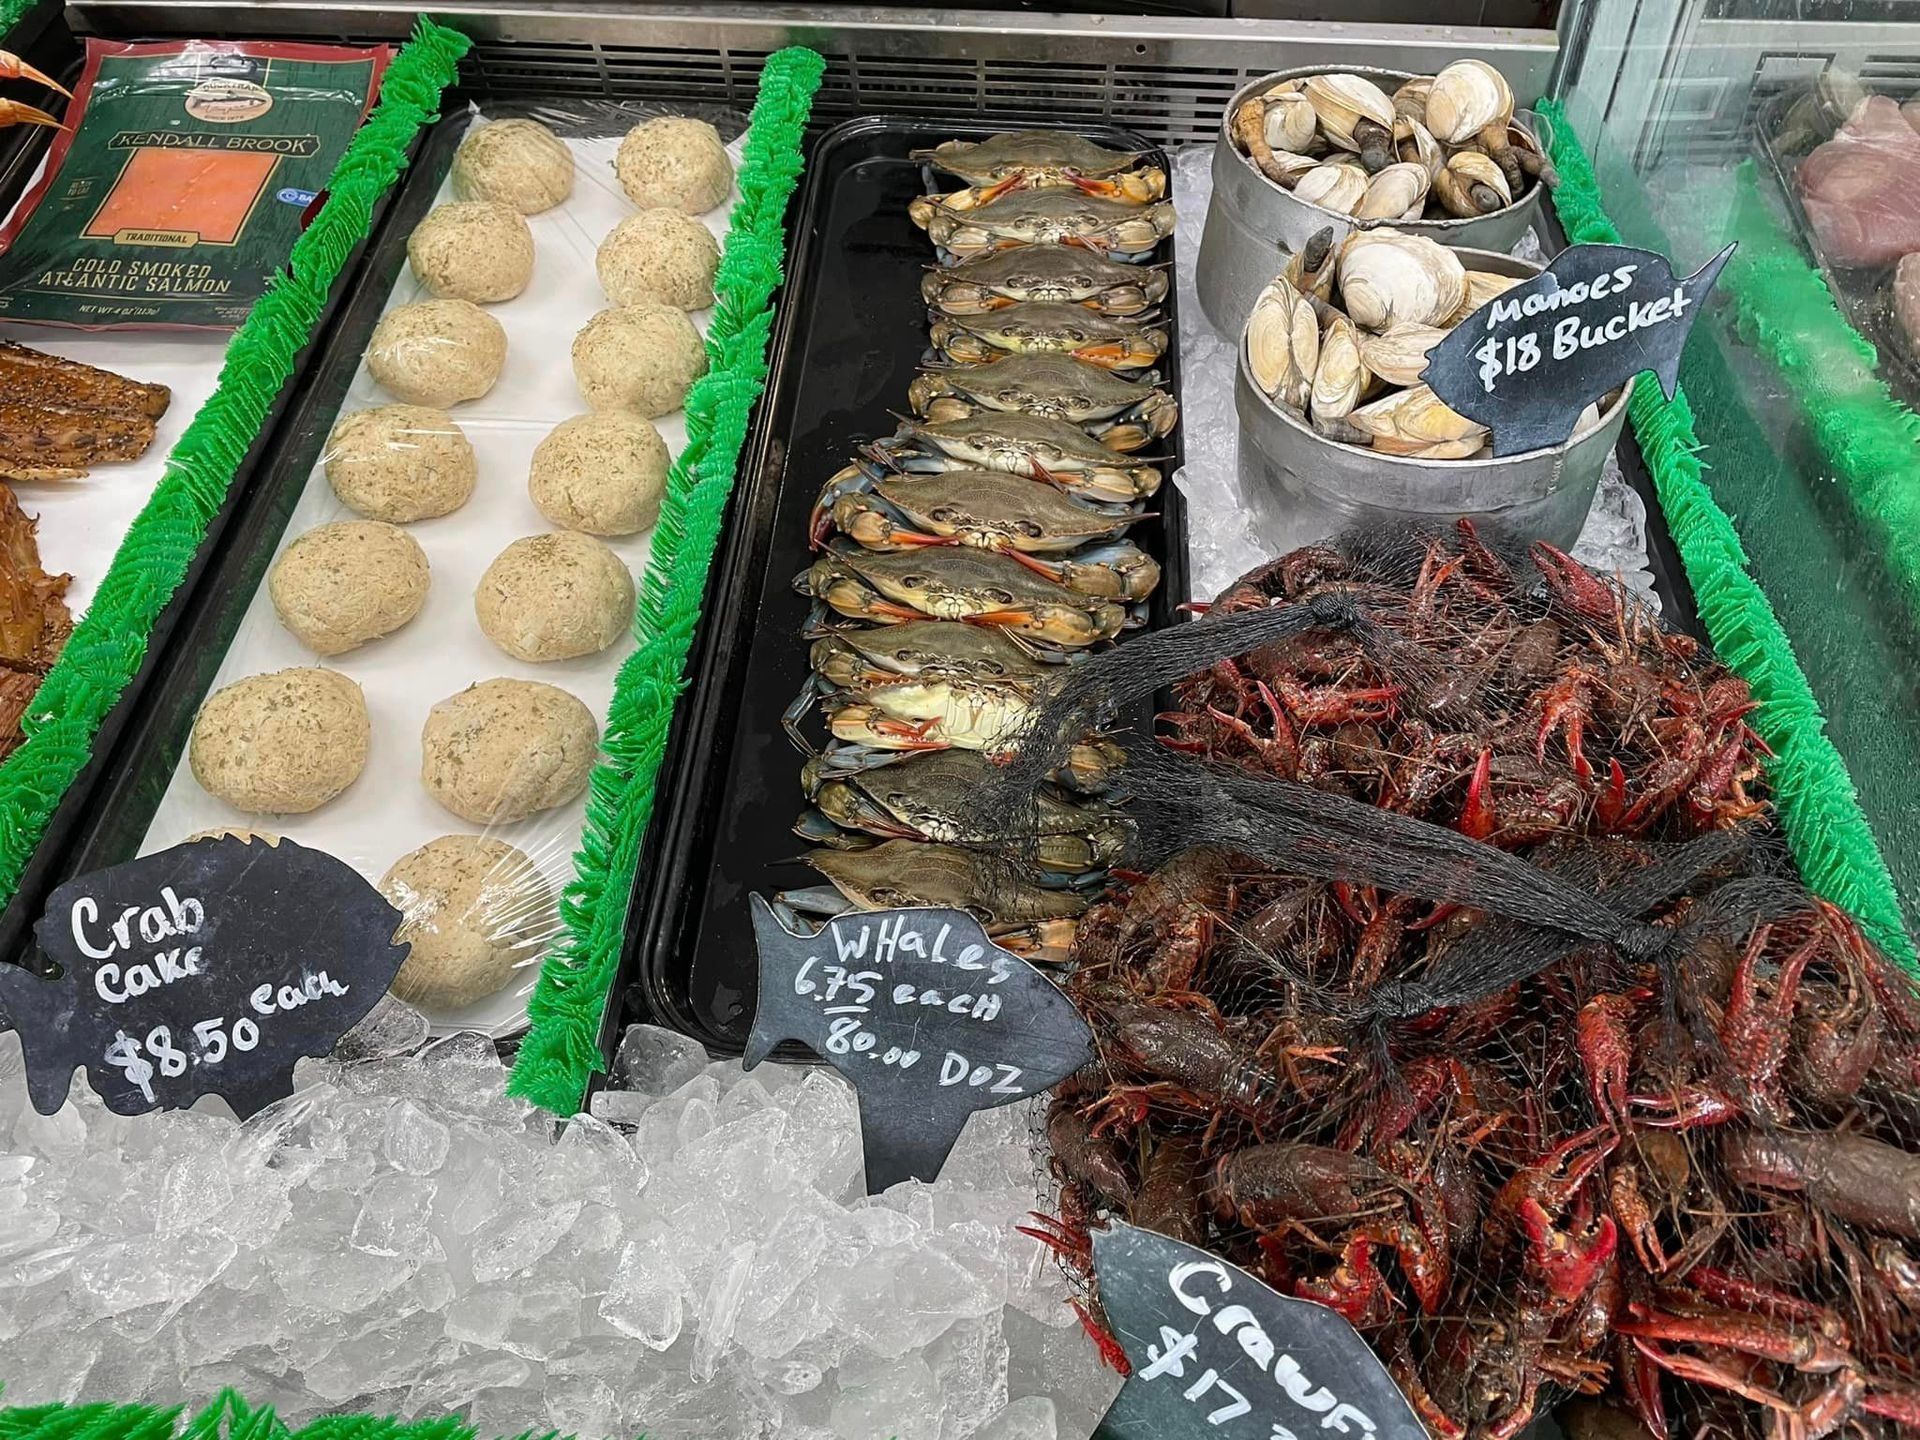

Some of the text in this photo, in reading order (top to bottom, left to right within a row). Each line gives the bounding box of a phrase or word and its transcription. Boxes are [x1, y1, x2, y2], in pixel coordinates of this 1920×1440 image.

[117, 133, 307, 153] KENDALL BROOK
[125, 233, 188, 244] TRADITIONAL
[38, 271, 231, 293] ATLANTIC SALMON
[72, 258, 212, 279] COLD SMOKED
[79, 304, 97, 313] NET
[1474, 287, 1692, 393] $18 Bucket
[71, 886, 205, 959] Crab
[794, 956, 884, 1004] 6.75
[104, 970, 350, 1104] $8.50 each
[1138, 1325, 1252, 1426] $17
